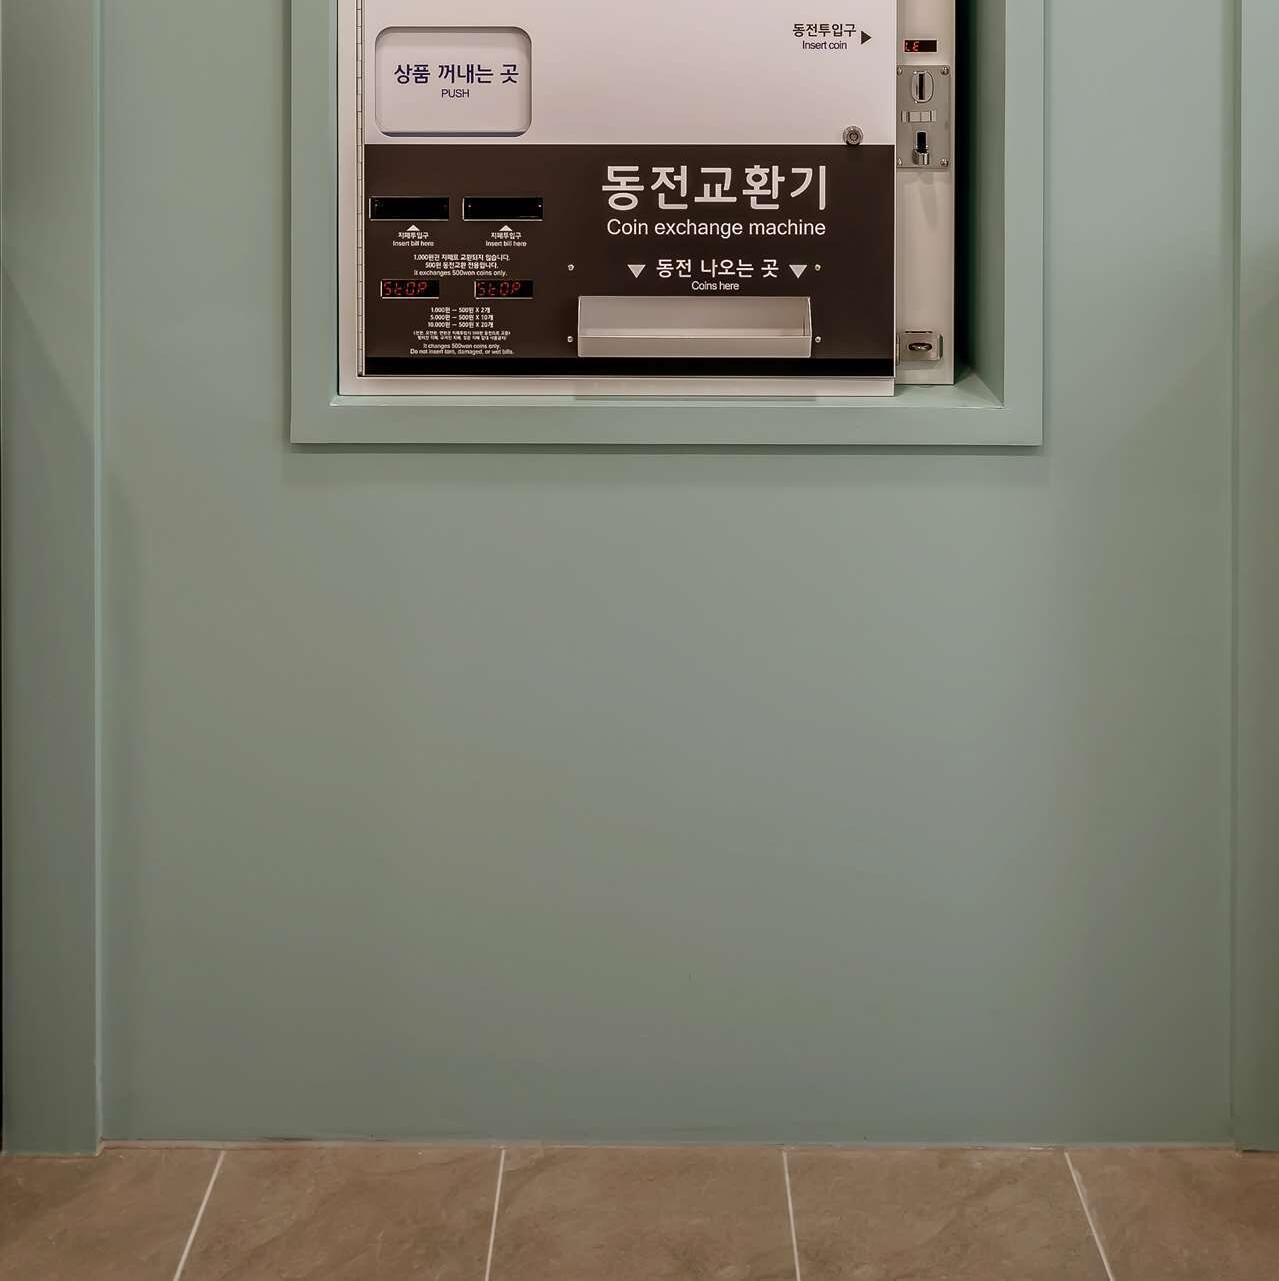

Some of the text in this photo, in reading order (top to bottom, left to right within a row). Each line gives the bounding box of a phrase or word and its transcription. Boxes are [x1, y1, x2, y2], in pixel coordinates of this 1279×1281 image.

[792, 23, 857, 38] 동전투입구
[802, 40, 848, 50] Insert coin
[394, 64, 518, 84] 상품 꺼내는 곳
[441, 88, 470, 99] PUSH
[602, 165, 826, 210] 동전교환기
[607, 219, 825, 239] Coin exchange machine
[418, 269, 452, 278] exchanges
[493, 269, 508, 277] only.
[657, 259, 779, 278] 동전 나오는 곳
[691, 280, 740, 291] Coins here
